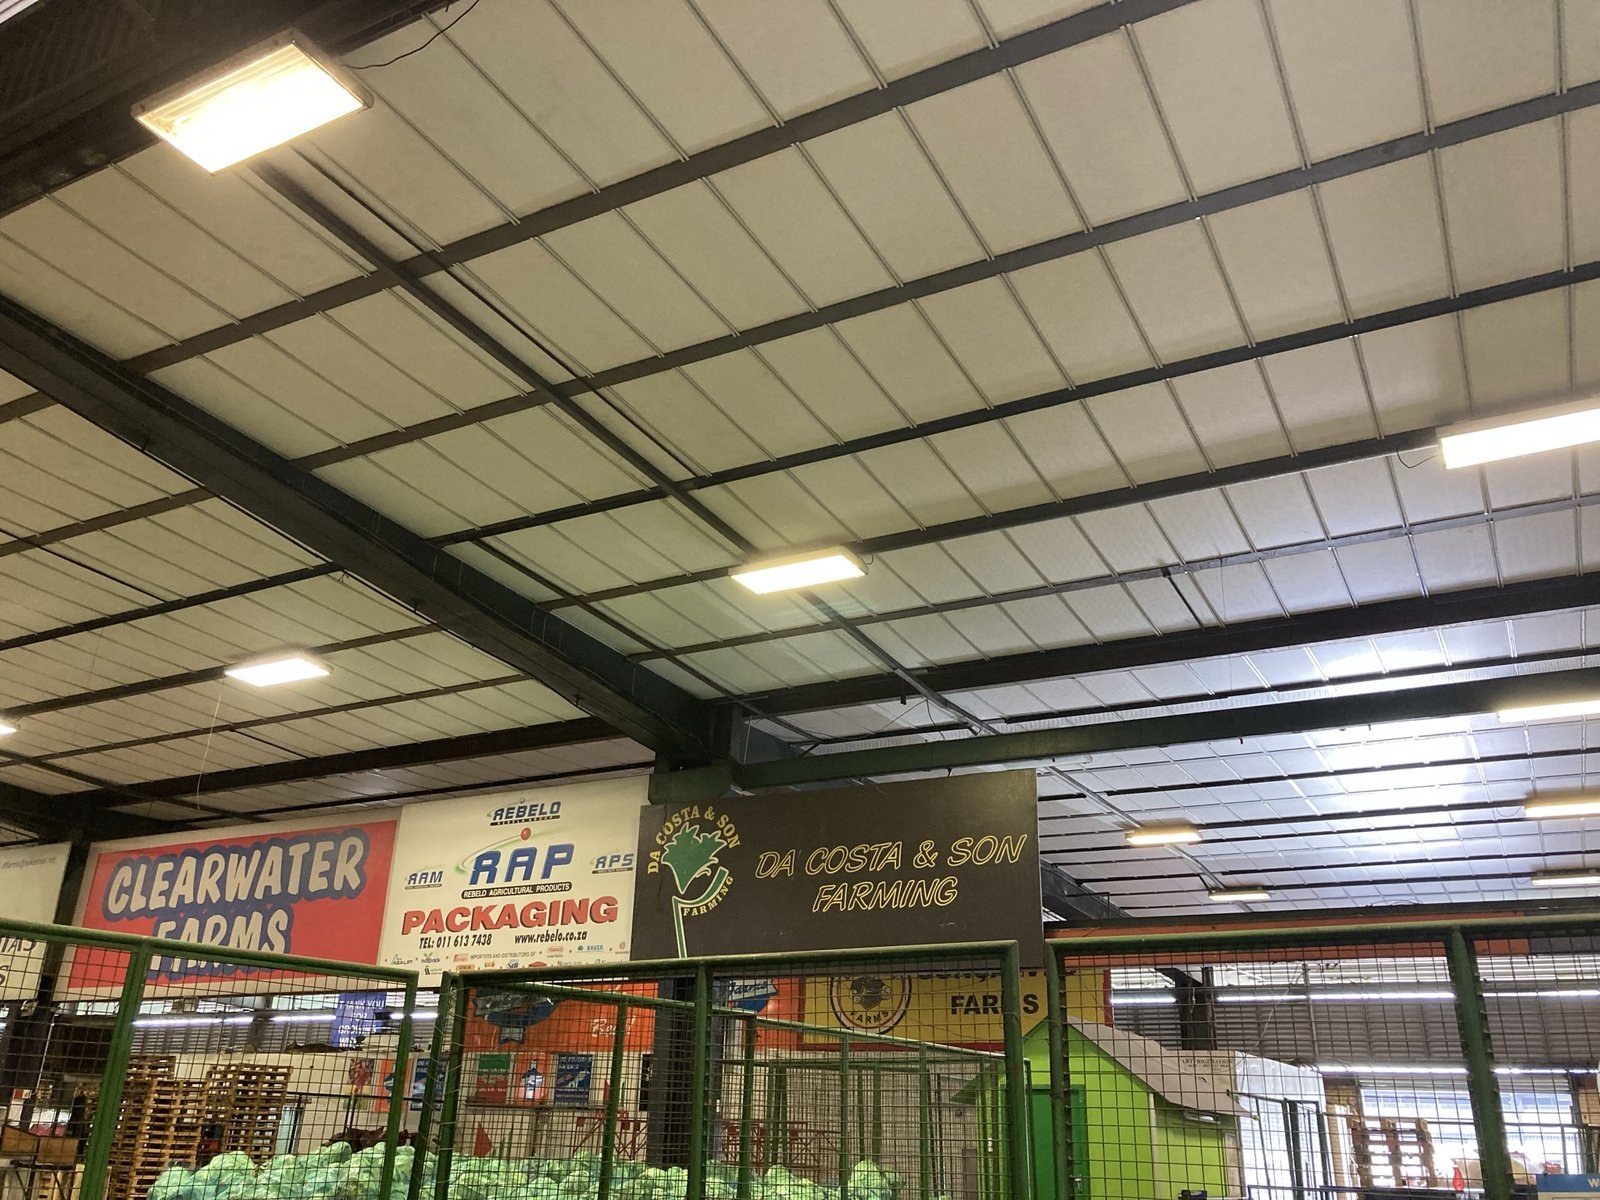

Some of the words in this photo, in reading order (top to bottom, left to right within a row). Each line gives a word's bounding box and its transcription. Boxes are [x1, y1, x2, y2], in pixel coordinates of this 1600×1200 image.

[493, 801, 561, 821] REBELO
[648, 850, 661, 874] DA
[656, 805, 701, 845] COSTA
[704, 806, 716, 820] &
[717, 814, 741, 849] SON
[755, 848, 796, 879] DA
[805, 841, 902, 875] COSTA
[912, 839, 939, 868] &
[947, 834, 1028, 865] SON
[107, 836, 364, 915] CLEARWATER
[469, 843, 575, 886] RAP
[463, 889, 487, 898] REBELO
[488, 885, 533, 896] AGRICULTURAL
[536, 883, 571, 892] PRODUCTS
[683, 876, 733, 916] FARMING
[812, 876, 958, 912] FARMING
[401, 896, 619, 935] PACKAGING
[150, 909, 288, 972] FARMS
[419, 937, 435, 949] TEL:
[436, 936, 452, 948] 011
[453, 935, 469, 947] 613
[471, 933, 492, 946] 7438
[514, 929, 588, 944] www.rebelo.co.za
[851, 1009, 890, 1025] FARMS
[951, 994, 1040, 1015] FARS
